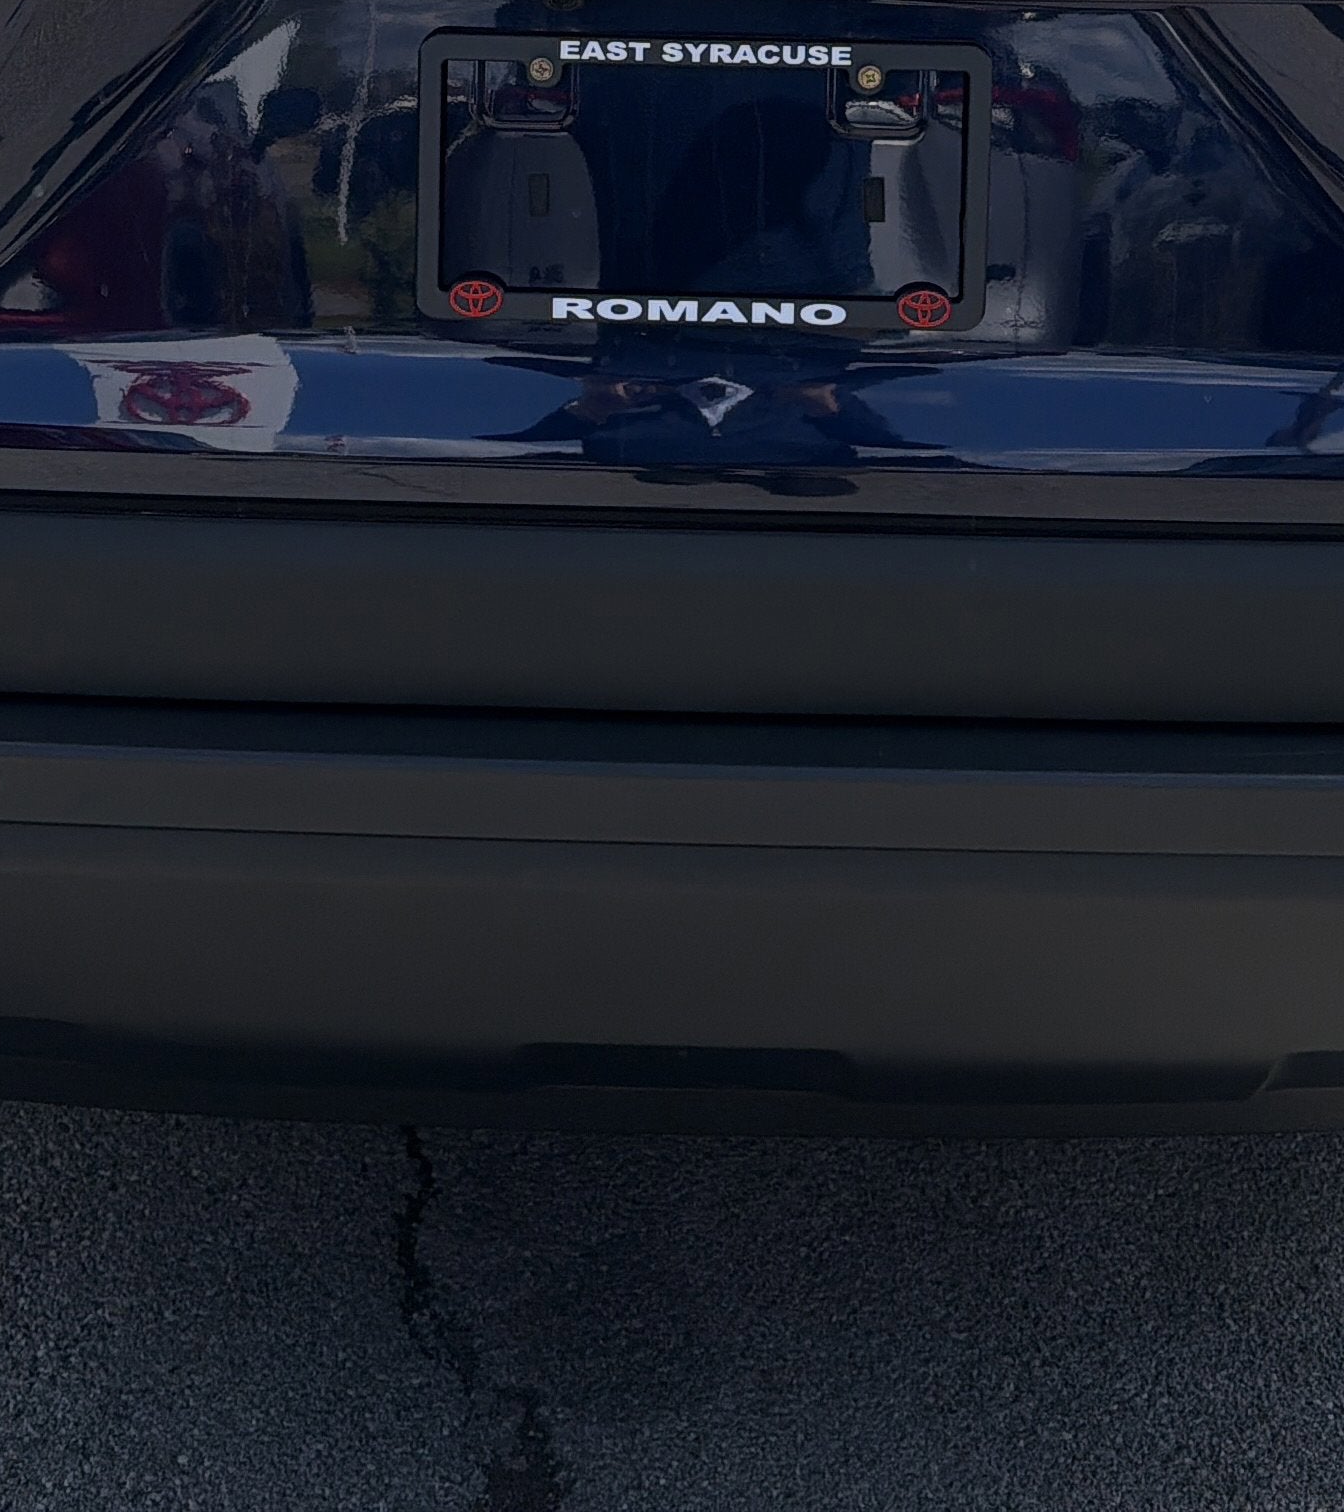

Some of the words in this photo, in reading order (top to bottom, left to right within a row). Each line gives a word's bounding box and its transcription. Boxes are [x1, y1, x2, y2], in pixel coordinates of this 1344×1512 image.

[559, 40, 651, 63] EAST
[662, 42, 854, 67] SYRACUSE
[551, 296, 848, 327] ROMANO
